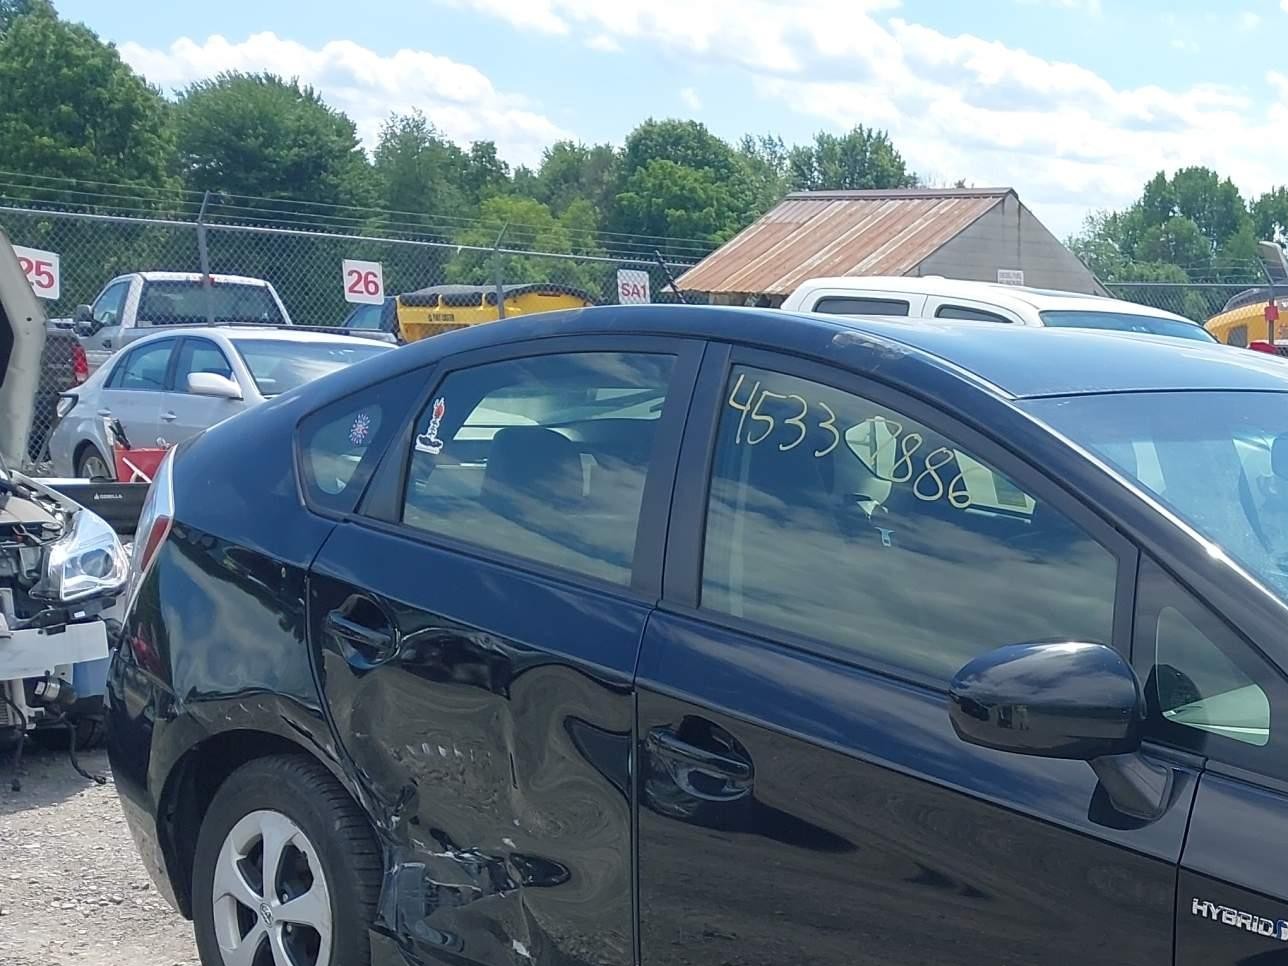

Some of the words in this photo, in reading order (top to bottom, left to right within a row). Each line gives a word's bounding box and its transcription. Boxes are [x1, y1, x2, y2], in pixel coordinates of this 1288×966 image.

[347, 269, 380, 296] 26
[621, 282, 647, 299] SA1
[729, 374, 978, 509] 45337886
[1191, 897, 1275, 938] HYBRID
